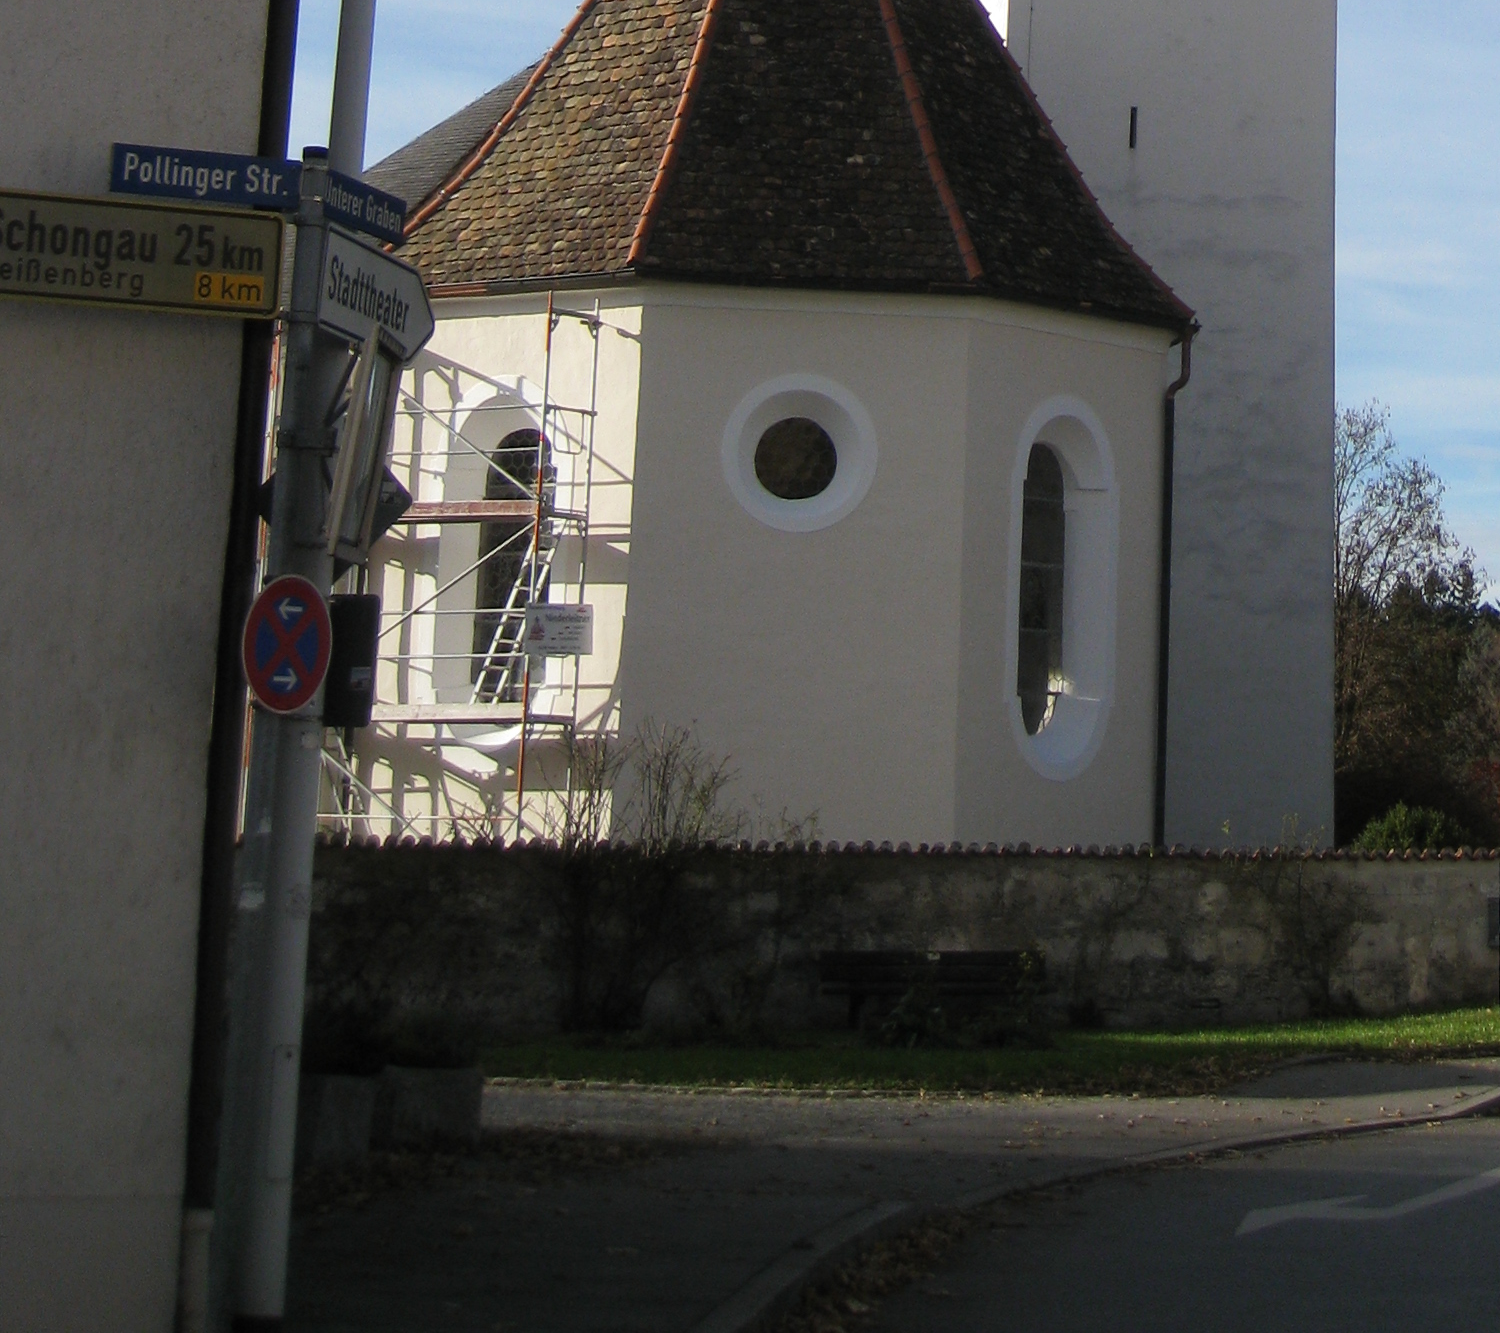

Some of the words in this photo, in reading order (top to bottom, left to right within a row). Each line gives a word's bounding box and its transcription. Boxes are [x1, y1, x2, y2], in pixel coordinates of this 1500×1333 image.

[123, 152, 237, 196] Pollinger
[245, 164, 288, 196] Str.
[324, 176, 363, 217] Unterer
[366, 194, 402, 233] Graben
[0, 208, 157, 271] chongau
[174, 223, 215, 268] 25
[222, 236, 264, 272] km
[0, 258, 144, 298] eißenberg
[198, 274, 212, 299] 8
[221, 277, 262, 303] km
[328, 254, 410, 334] Stadttheater
